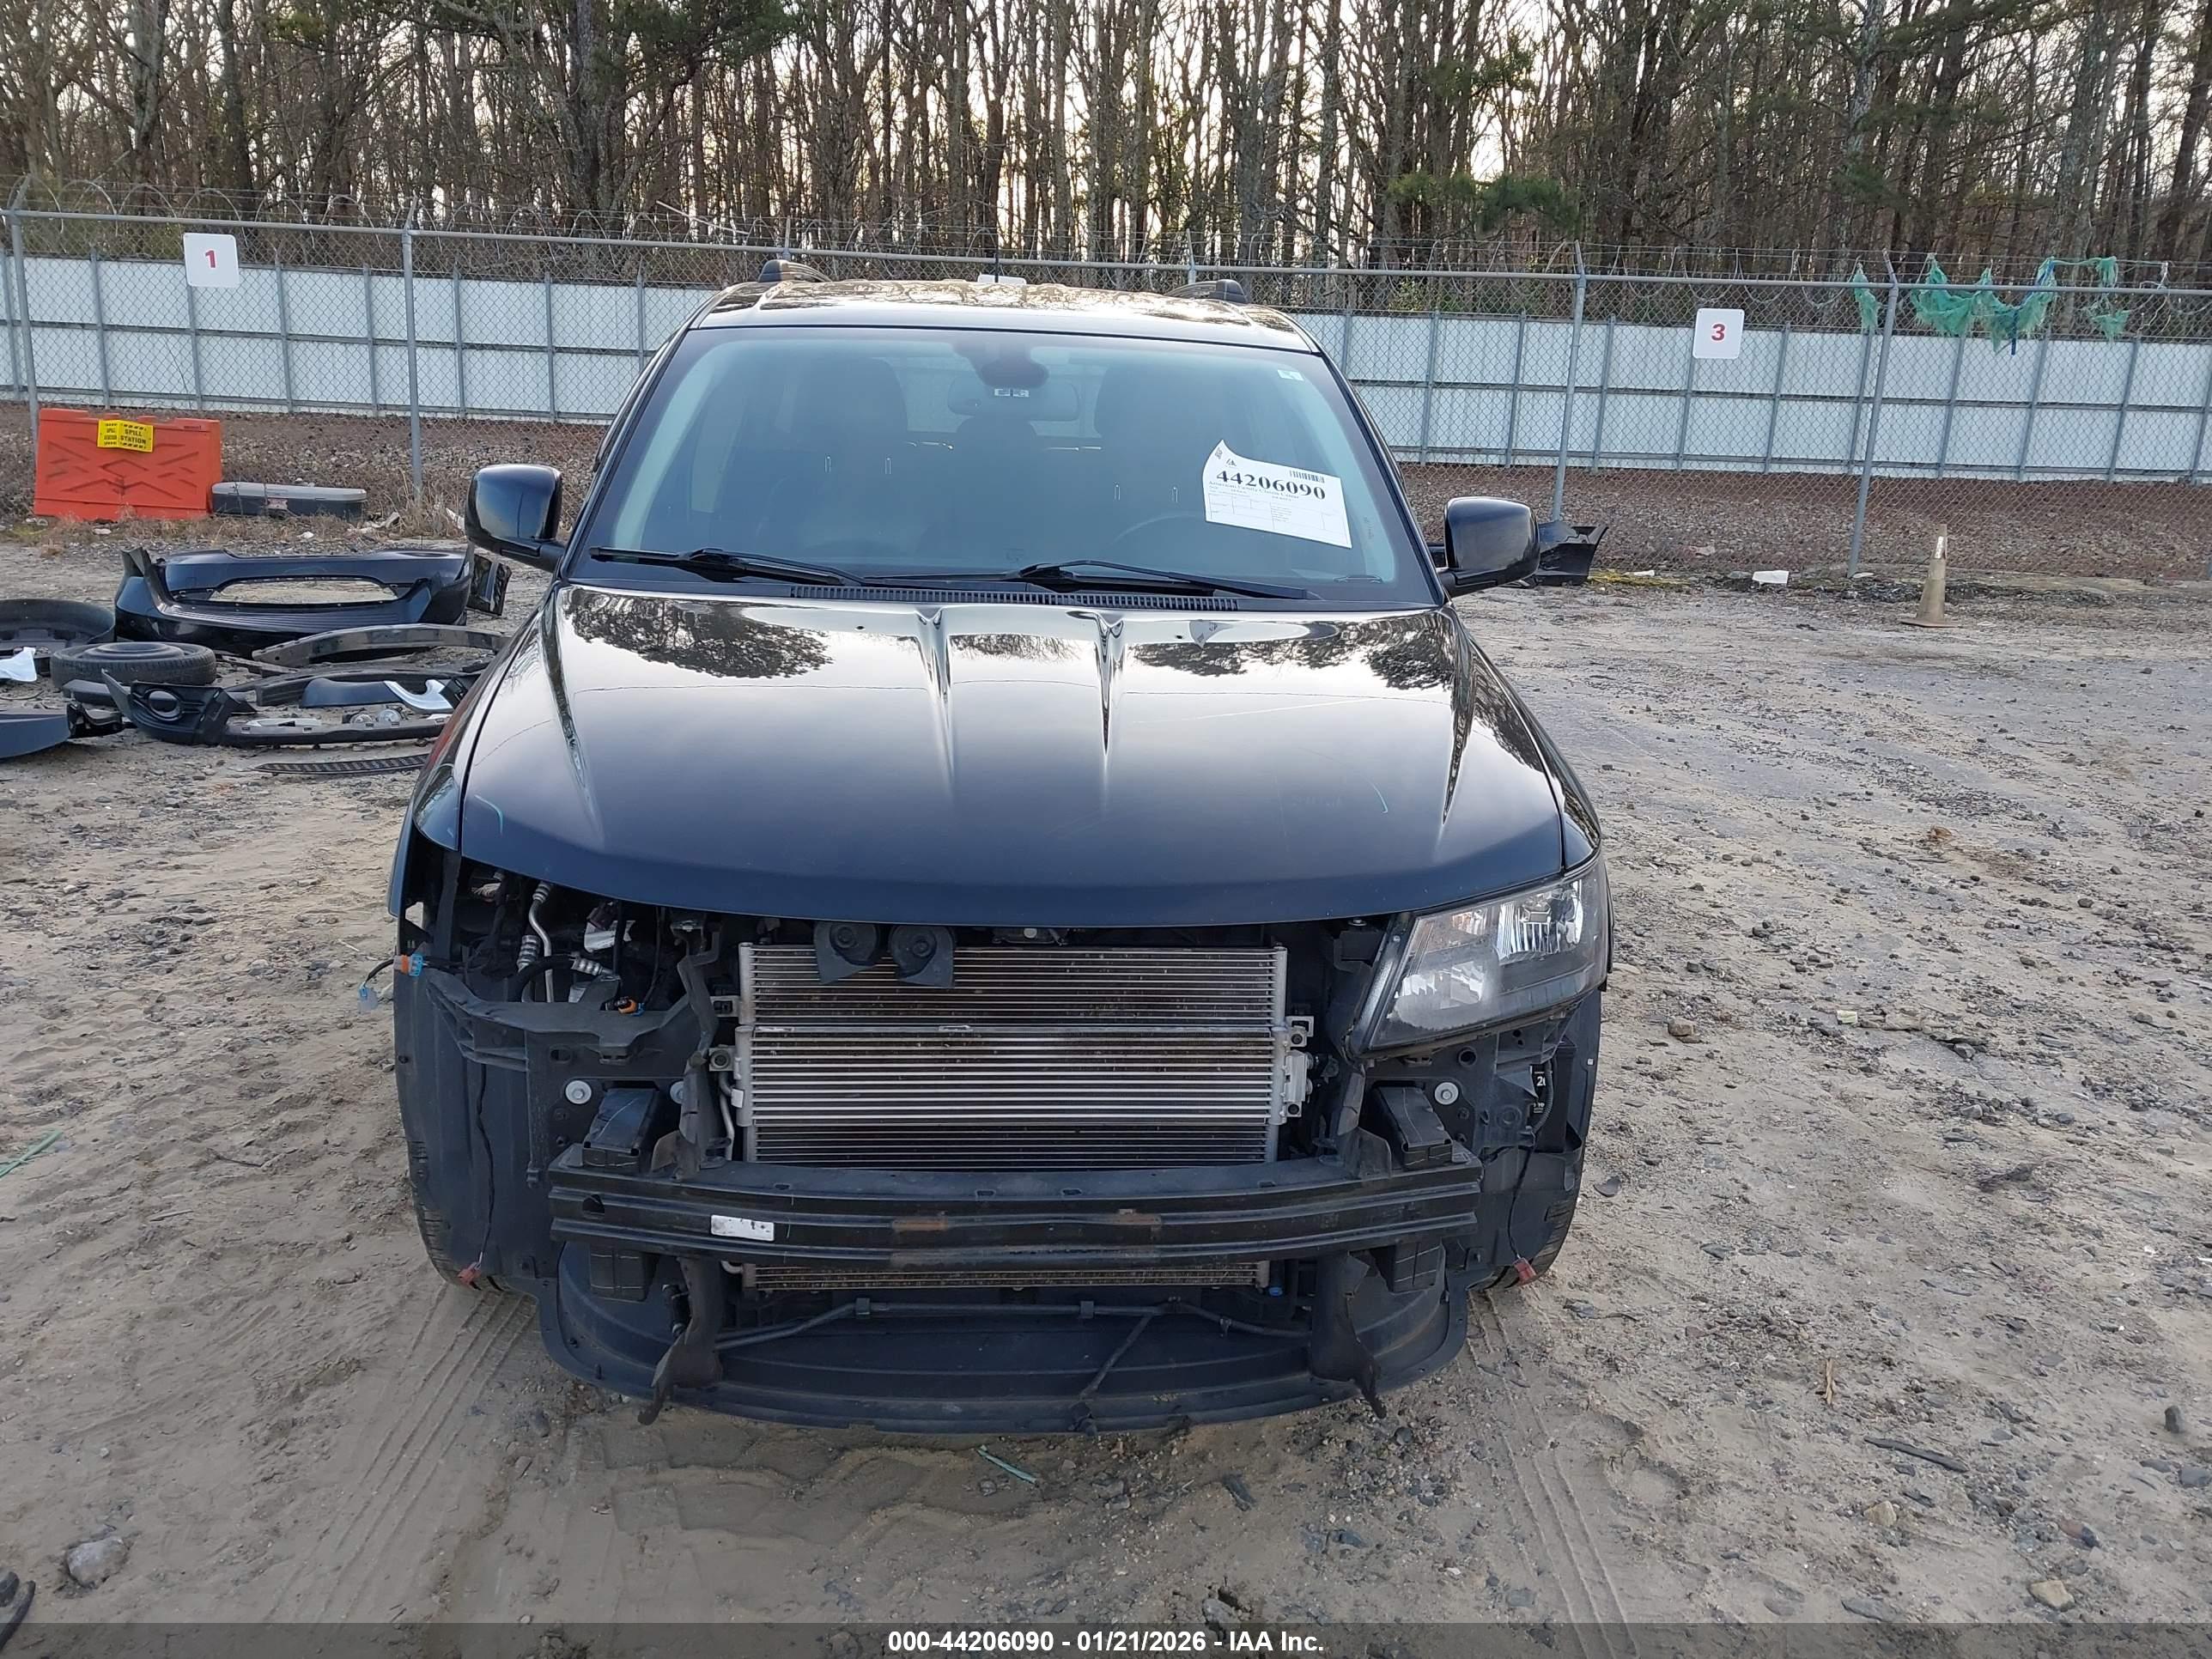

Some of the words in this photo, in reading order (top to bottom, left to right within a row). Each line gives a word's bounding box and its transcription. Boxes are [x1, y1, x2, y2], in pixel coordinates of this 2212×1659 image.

[204, 250, 216, 268] 1
[1711, 324, 1725, 341] 3
[120, 434, 146, 444] STATION
[1216, 471, 1326, 500] 44206090
